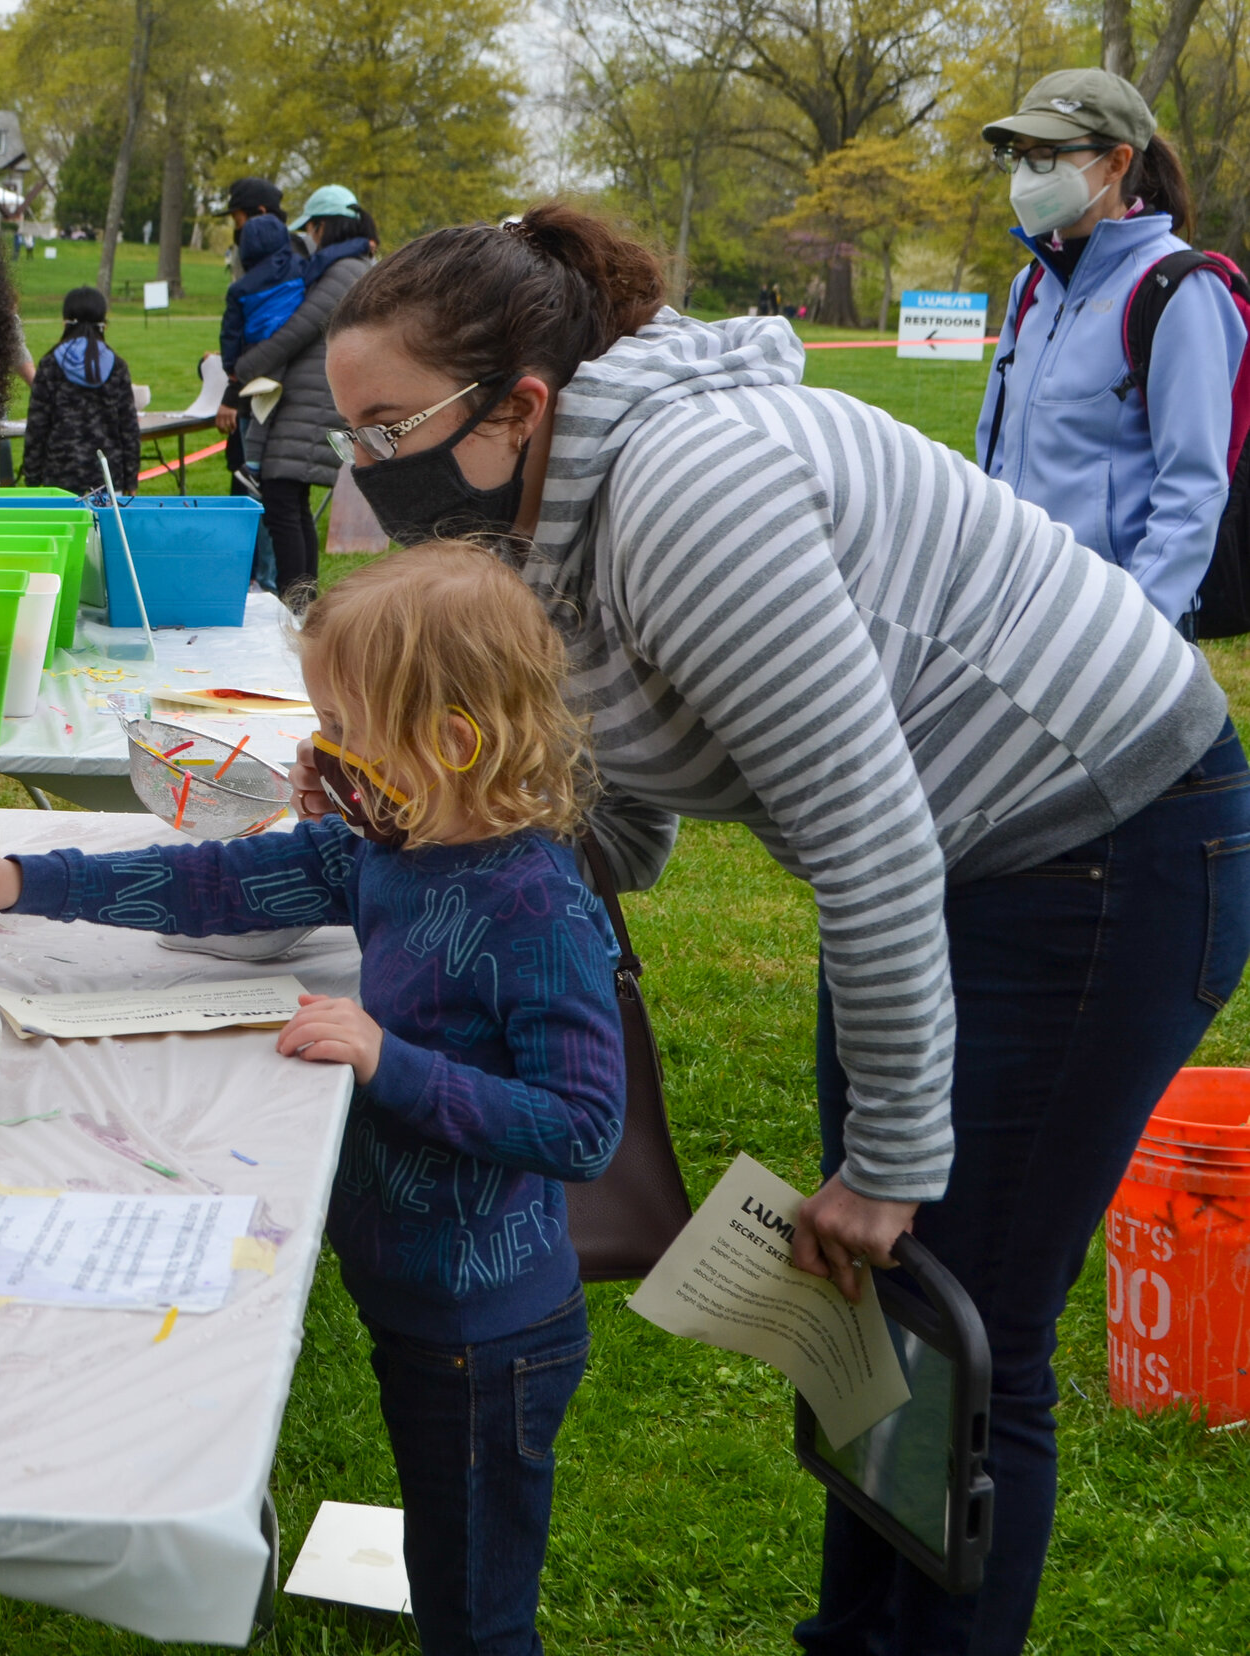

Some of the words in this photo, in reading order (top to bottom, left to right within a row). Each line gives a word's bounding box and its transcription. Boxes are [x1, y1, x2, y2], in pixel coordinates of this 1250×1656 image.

[904, 316, 981, 327] RESTROOMS
[716, 1236, 732, 1249] Use
[729, 1219, 768, 1249] SECRET
[1106, 1210, 1173, 1262] ET'S
[711, 1244, 731, 1262] paper
[694, 1266, 714, 1285] about
[698, 1259, 718, 1277] Bring
[716, 1272, 733, 1288] your
[732, 1282, 760, 1299] message
[682, 1281, 698, 1296] With
[697, 1292, 710, 1304] the
